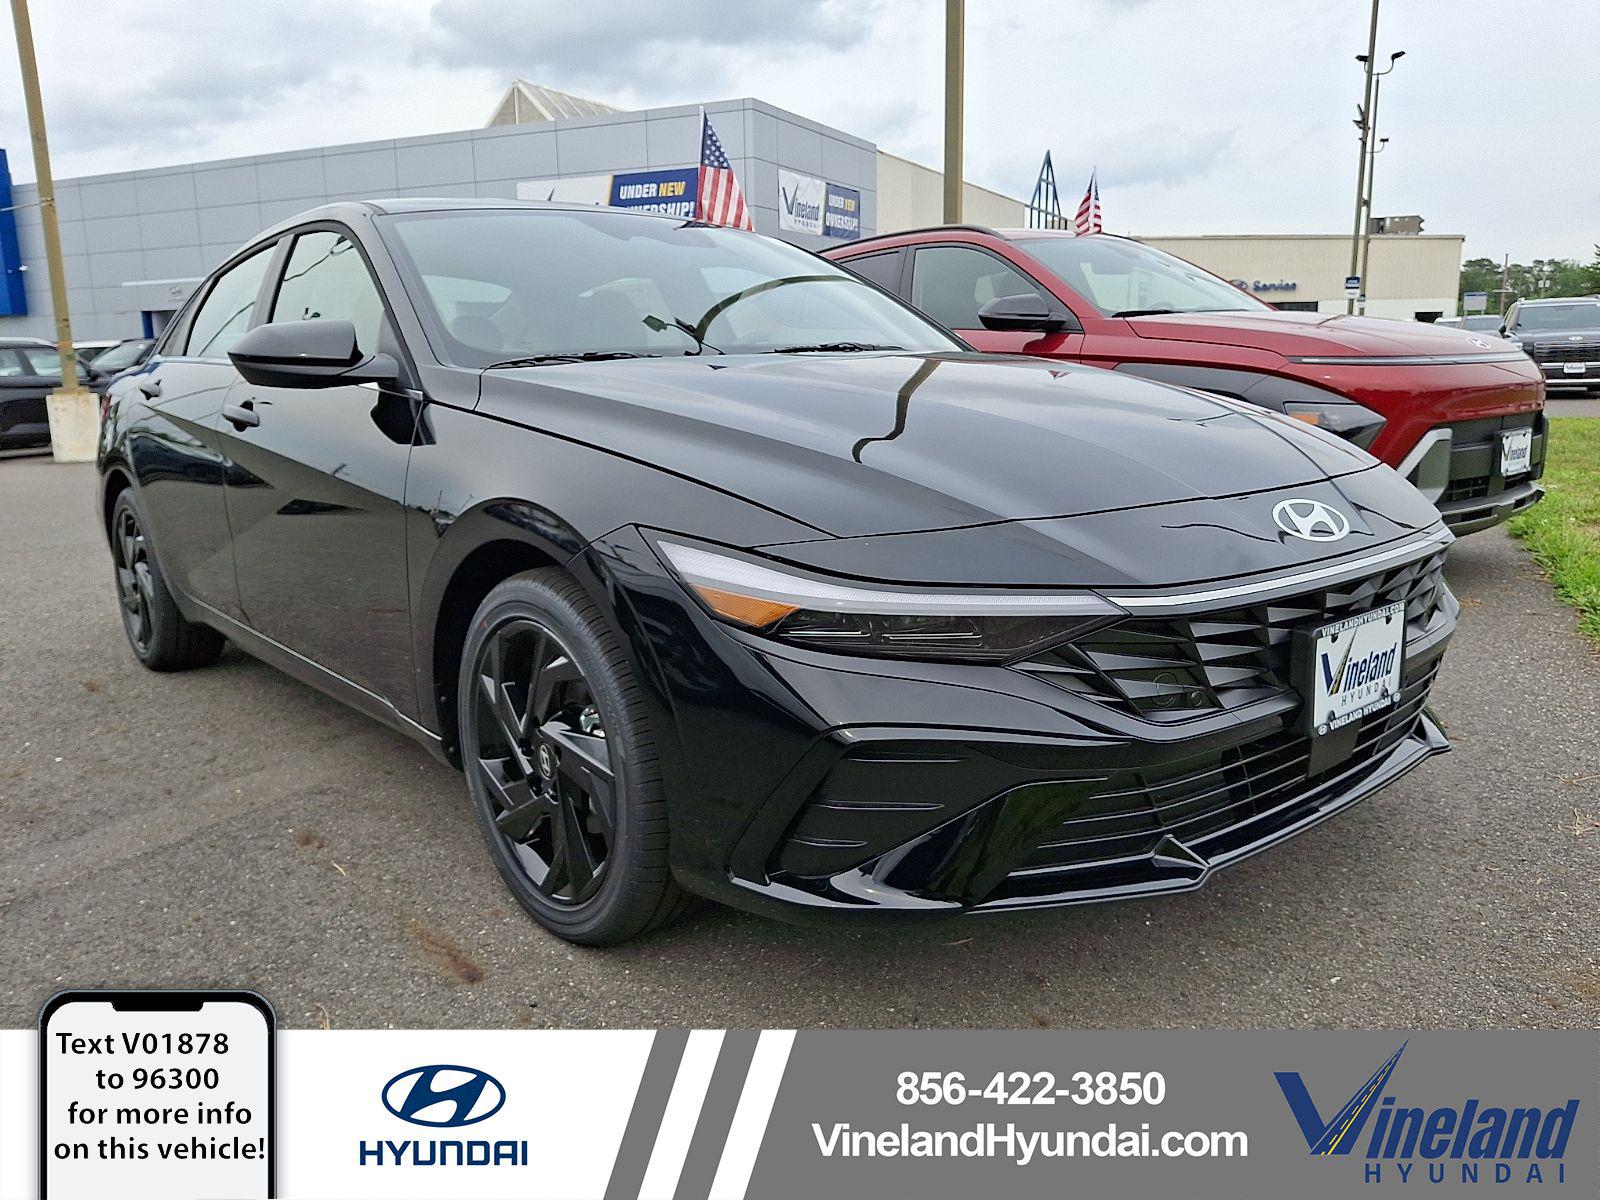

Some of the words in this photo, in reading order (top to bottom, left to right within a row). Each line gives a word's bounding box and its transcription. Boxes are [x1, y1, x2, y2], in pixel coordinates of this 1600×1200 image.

[620, 183, 658, 200] UNDER
[659, 181, 686, 197] NEW
[782, 184, 820, 221] Vineland
[825, 212, 859, 232] OWNERSHIP!
[1253, 279, 1297, 292] Service
[1321, 602, 1405, 636] VINELANDHYUNDAI.COM
[1320, 627, 1398, 697] Vineland
[1341, 681, 1392, 706] HYUNDAI
[1330, 710, 1363, 730] VINELAND
[1363, 697, 1392, 716] HYUNDAI
